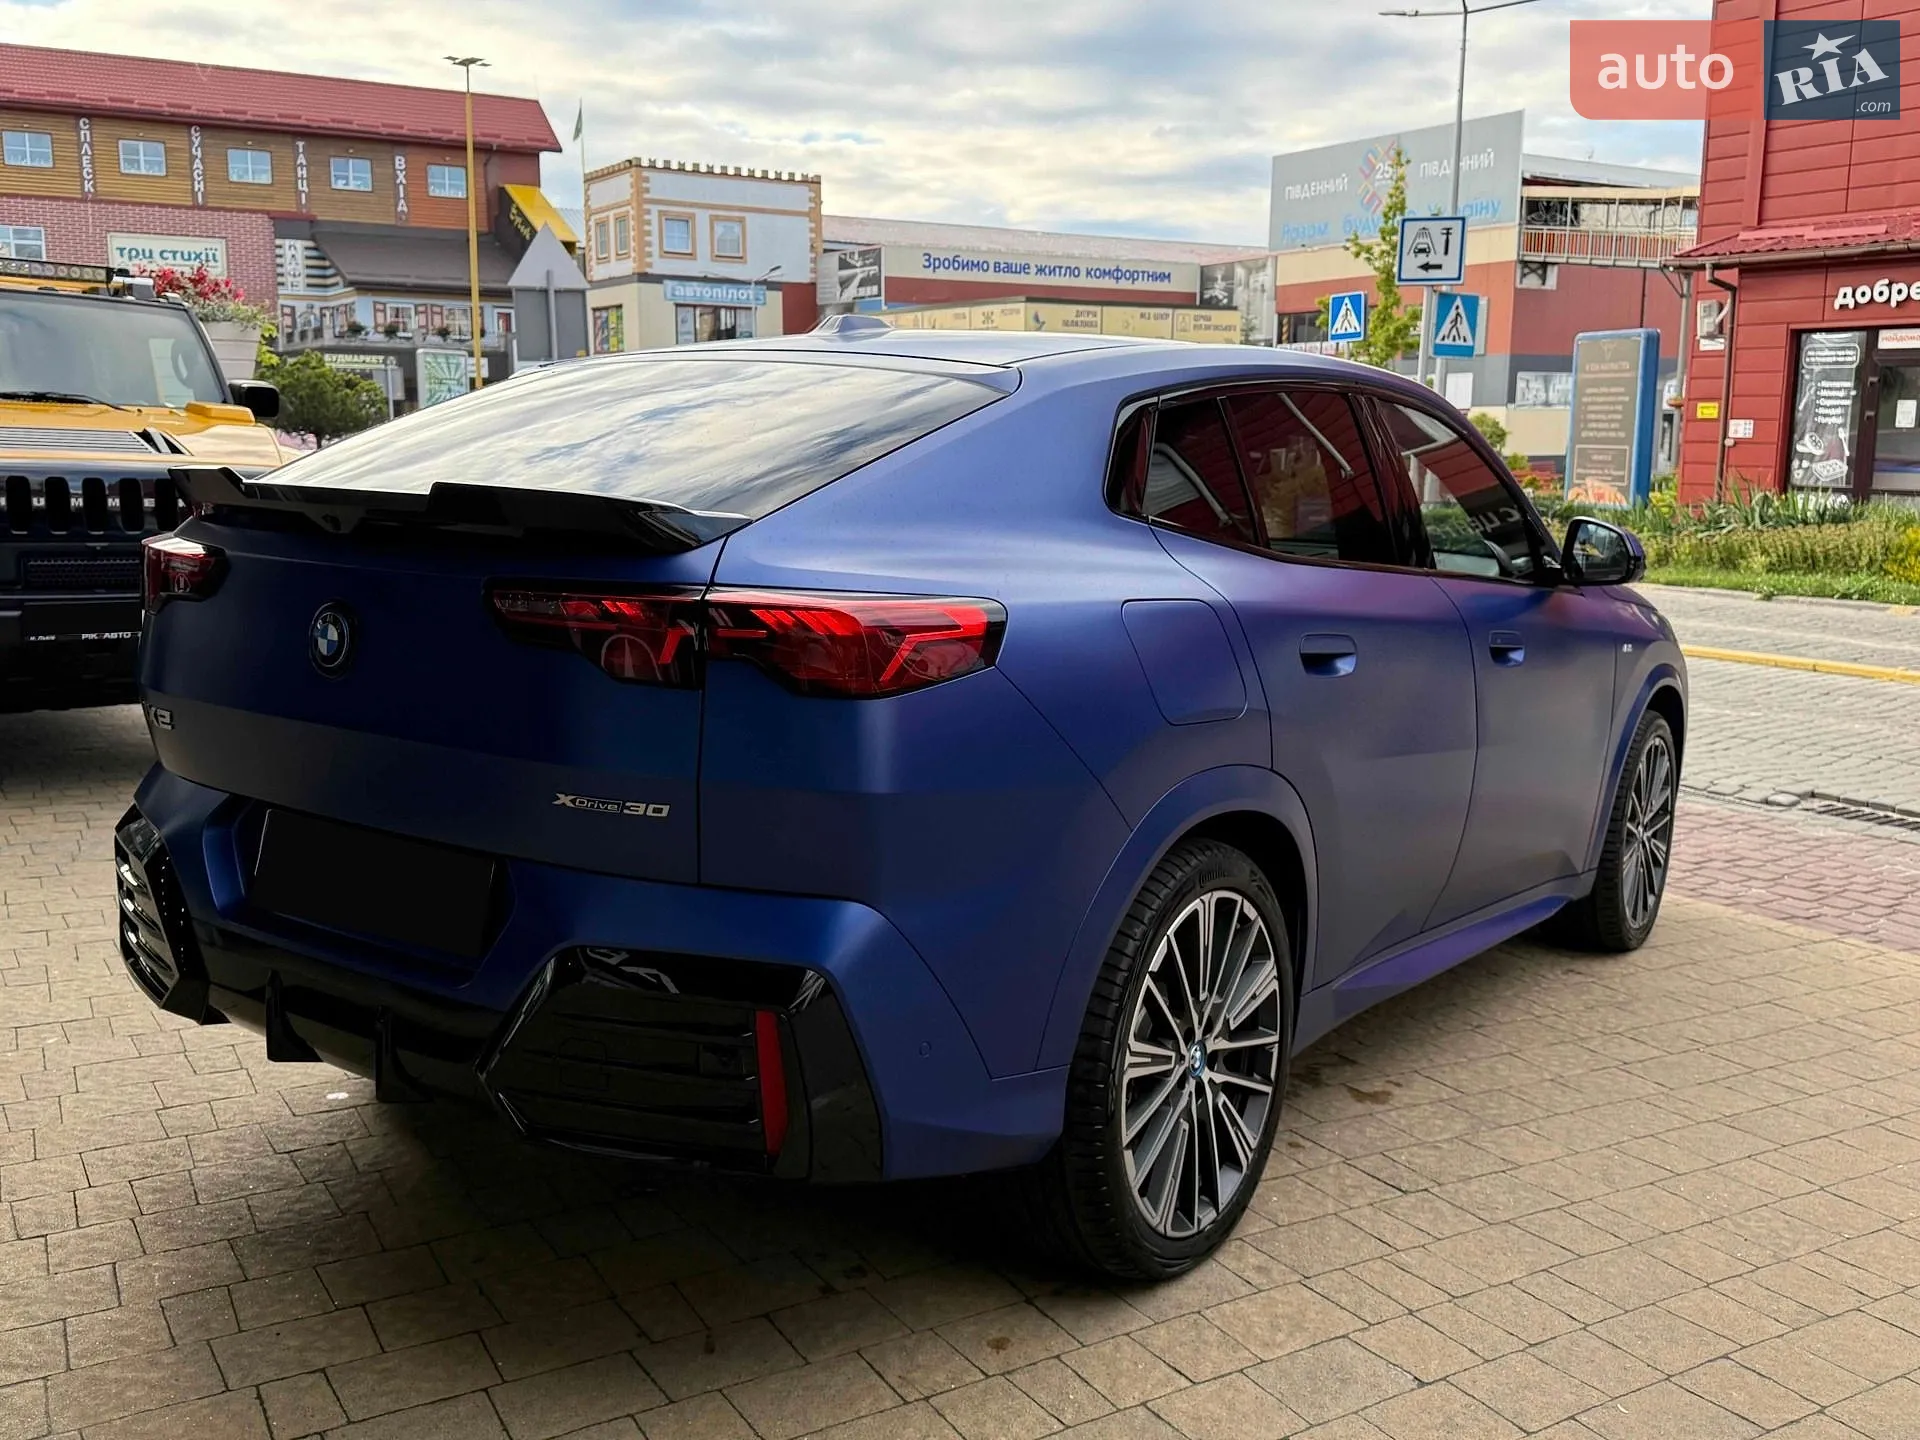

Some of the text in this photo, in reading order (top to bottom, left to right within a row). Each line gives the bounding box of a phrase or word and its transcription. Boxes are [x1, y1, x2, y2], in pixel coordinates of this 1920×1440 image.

[1420, 148, 1495, 178] ПІВДННИЙ
[1285, 173, 1349, 201] ПІВДЕННИЙ
[922, 252, 1172, 285] Зробимо ваше житло комфортним
